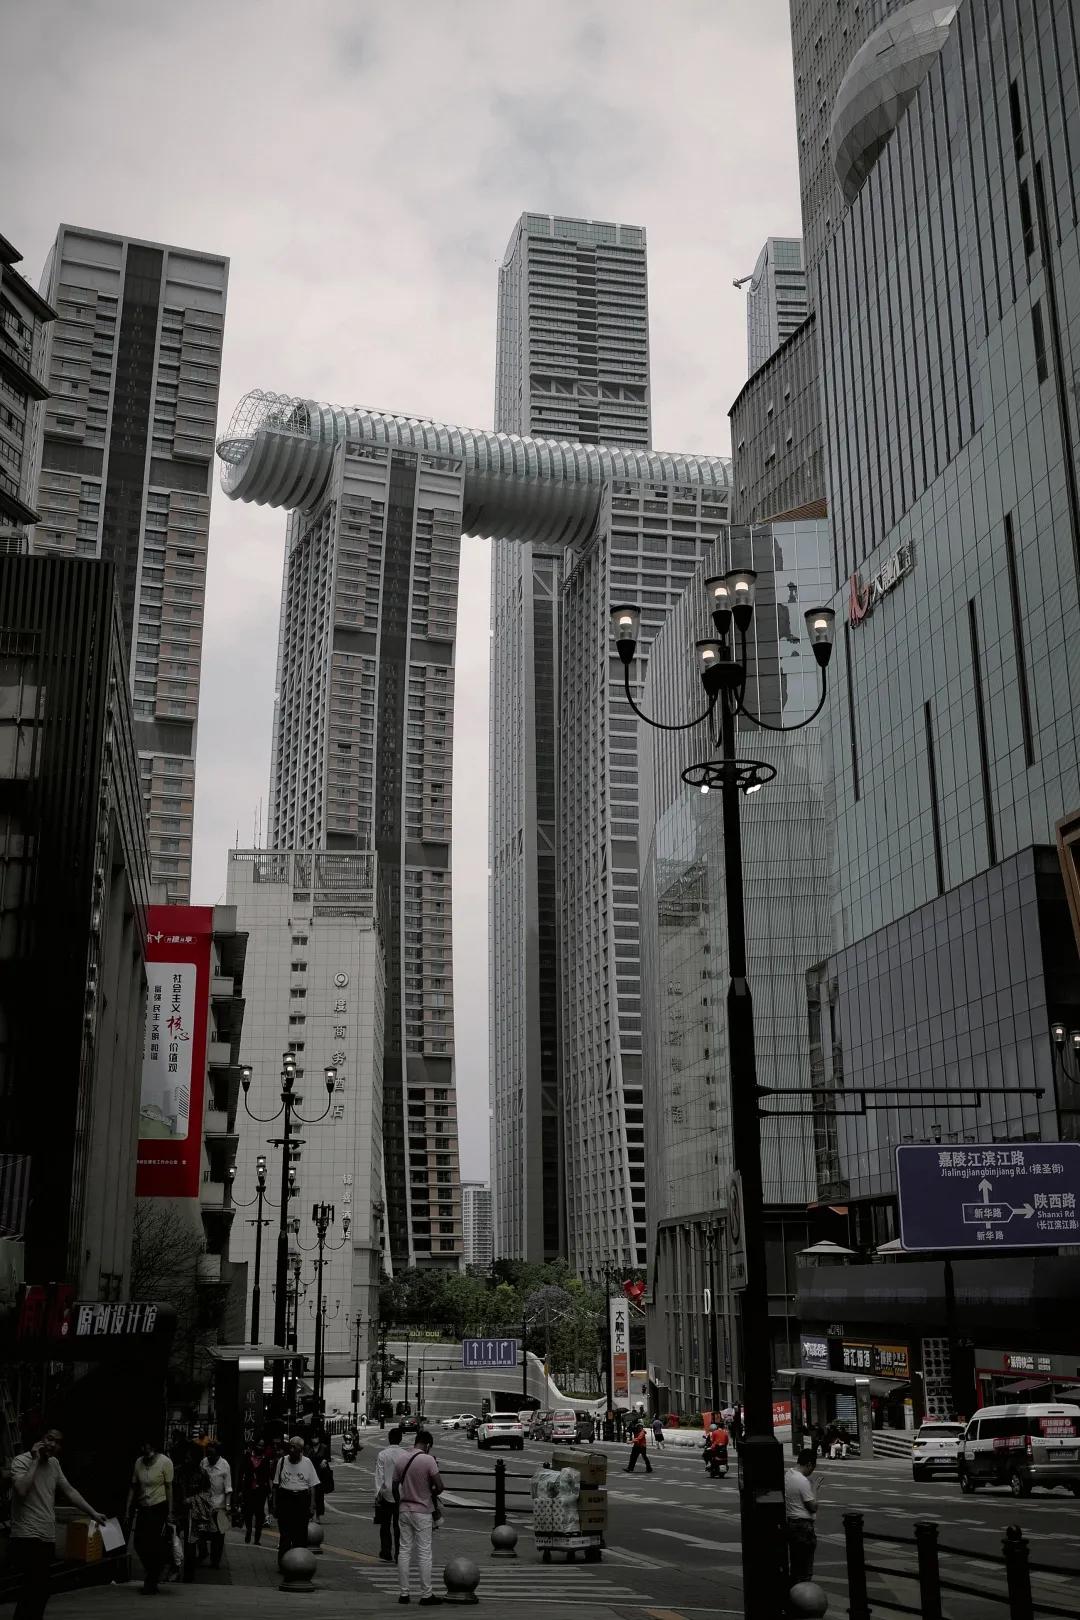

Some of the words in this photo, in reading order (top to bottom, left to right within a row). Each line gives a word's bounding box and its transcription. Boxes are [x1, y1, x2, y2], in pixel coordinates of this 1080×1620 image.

[166, 974, 190, 1073] 社会主义核心价值观
[938, 1150, 1025, 1168] 嘉陵江滨江路
[941, 1168, 1015, 1178] Jialingjiangbinjiang
[1033, 1192, 1076, 1209] 陕西路
[974, 1207, 1002, 1218] 新华路
[1037, 1210, 1063, 1218] Shanxi
[1064, 1210, 1075, 1218] Rd
[1036, 1220, 1079, 1230] (长江滨江路)
[976, 1230, 1004, 1241] 新华路
[76, 1303, 158, 1336] 原创设计馆
